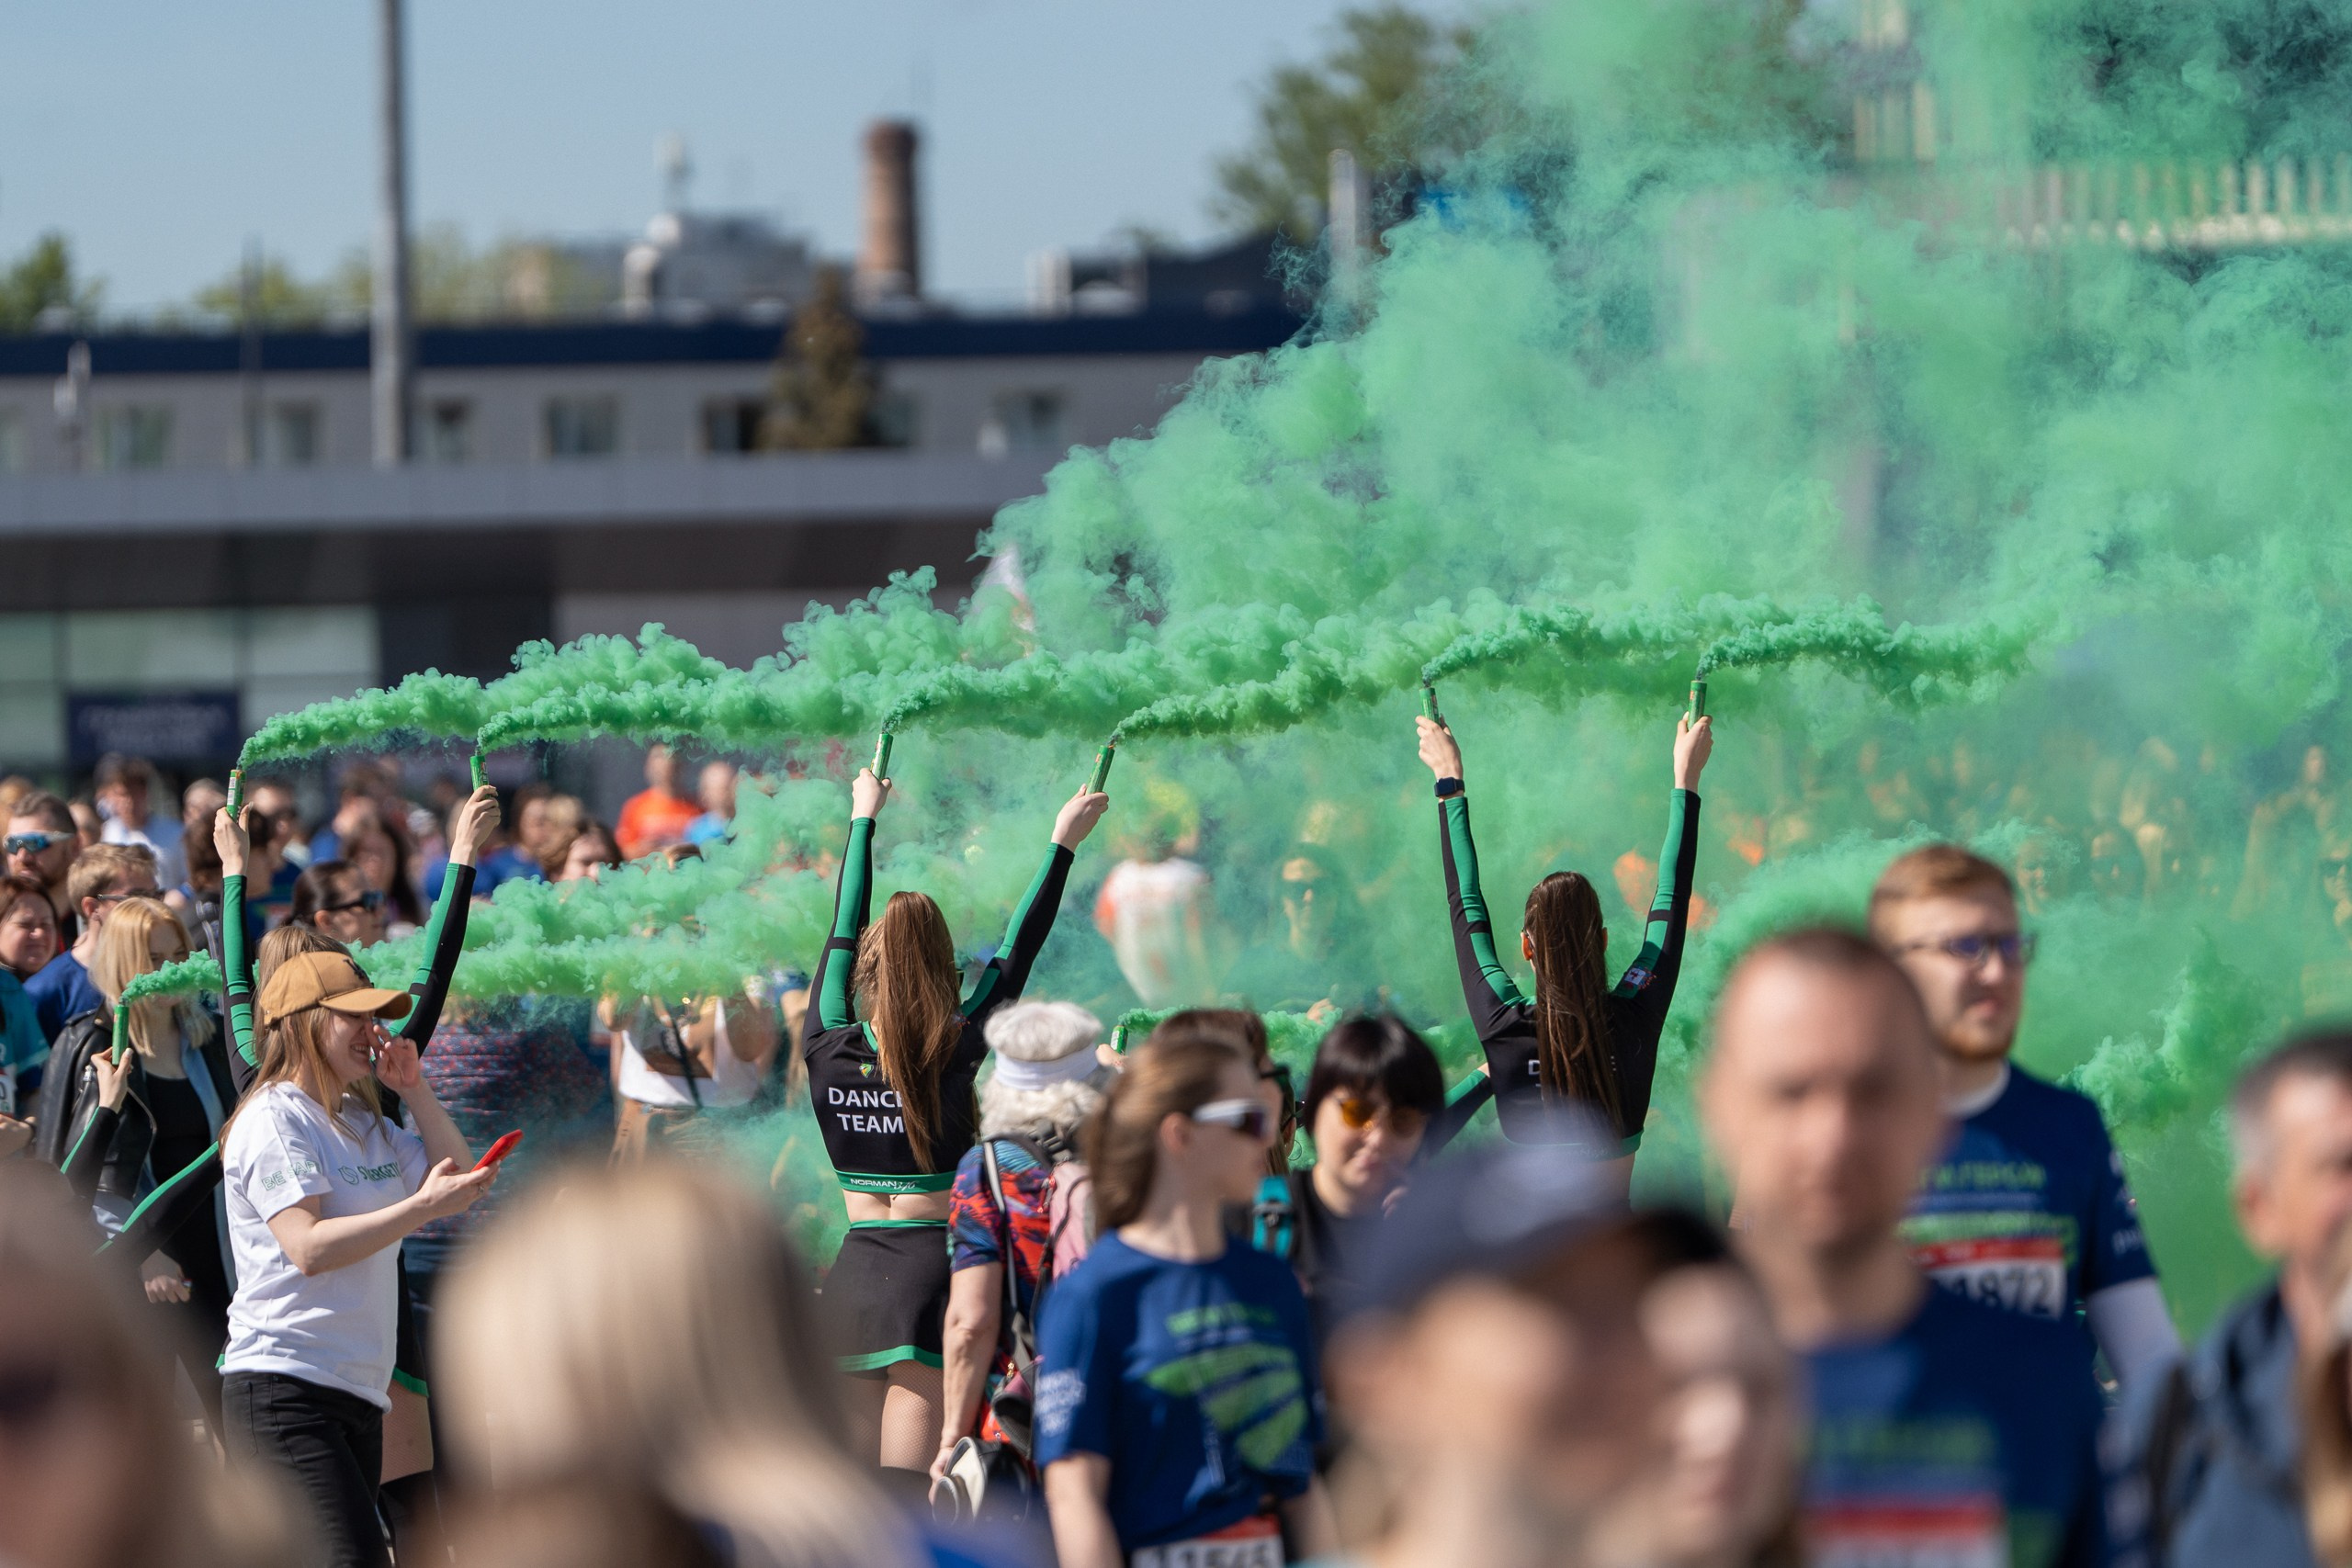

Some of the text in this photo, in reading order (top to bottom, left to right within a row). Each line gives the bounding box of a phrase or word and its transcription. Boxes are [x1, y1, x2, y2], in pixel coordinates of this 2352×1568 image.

[836, 1112, 905, 1134] TEAM
[261, 1170, 287, 1191] BE
[850, 1179, 897, 1188] NORMAN
